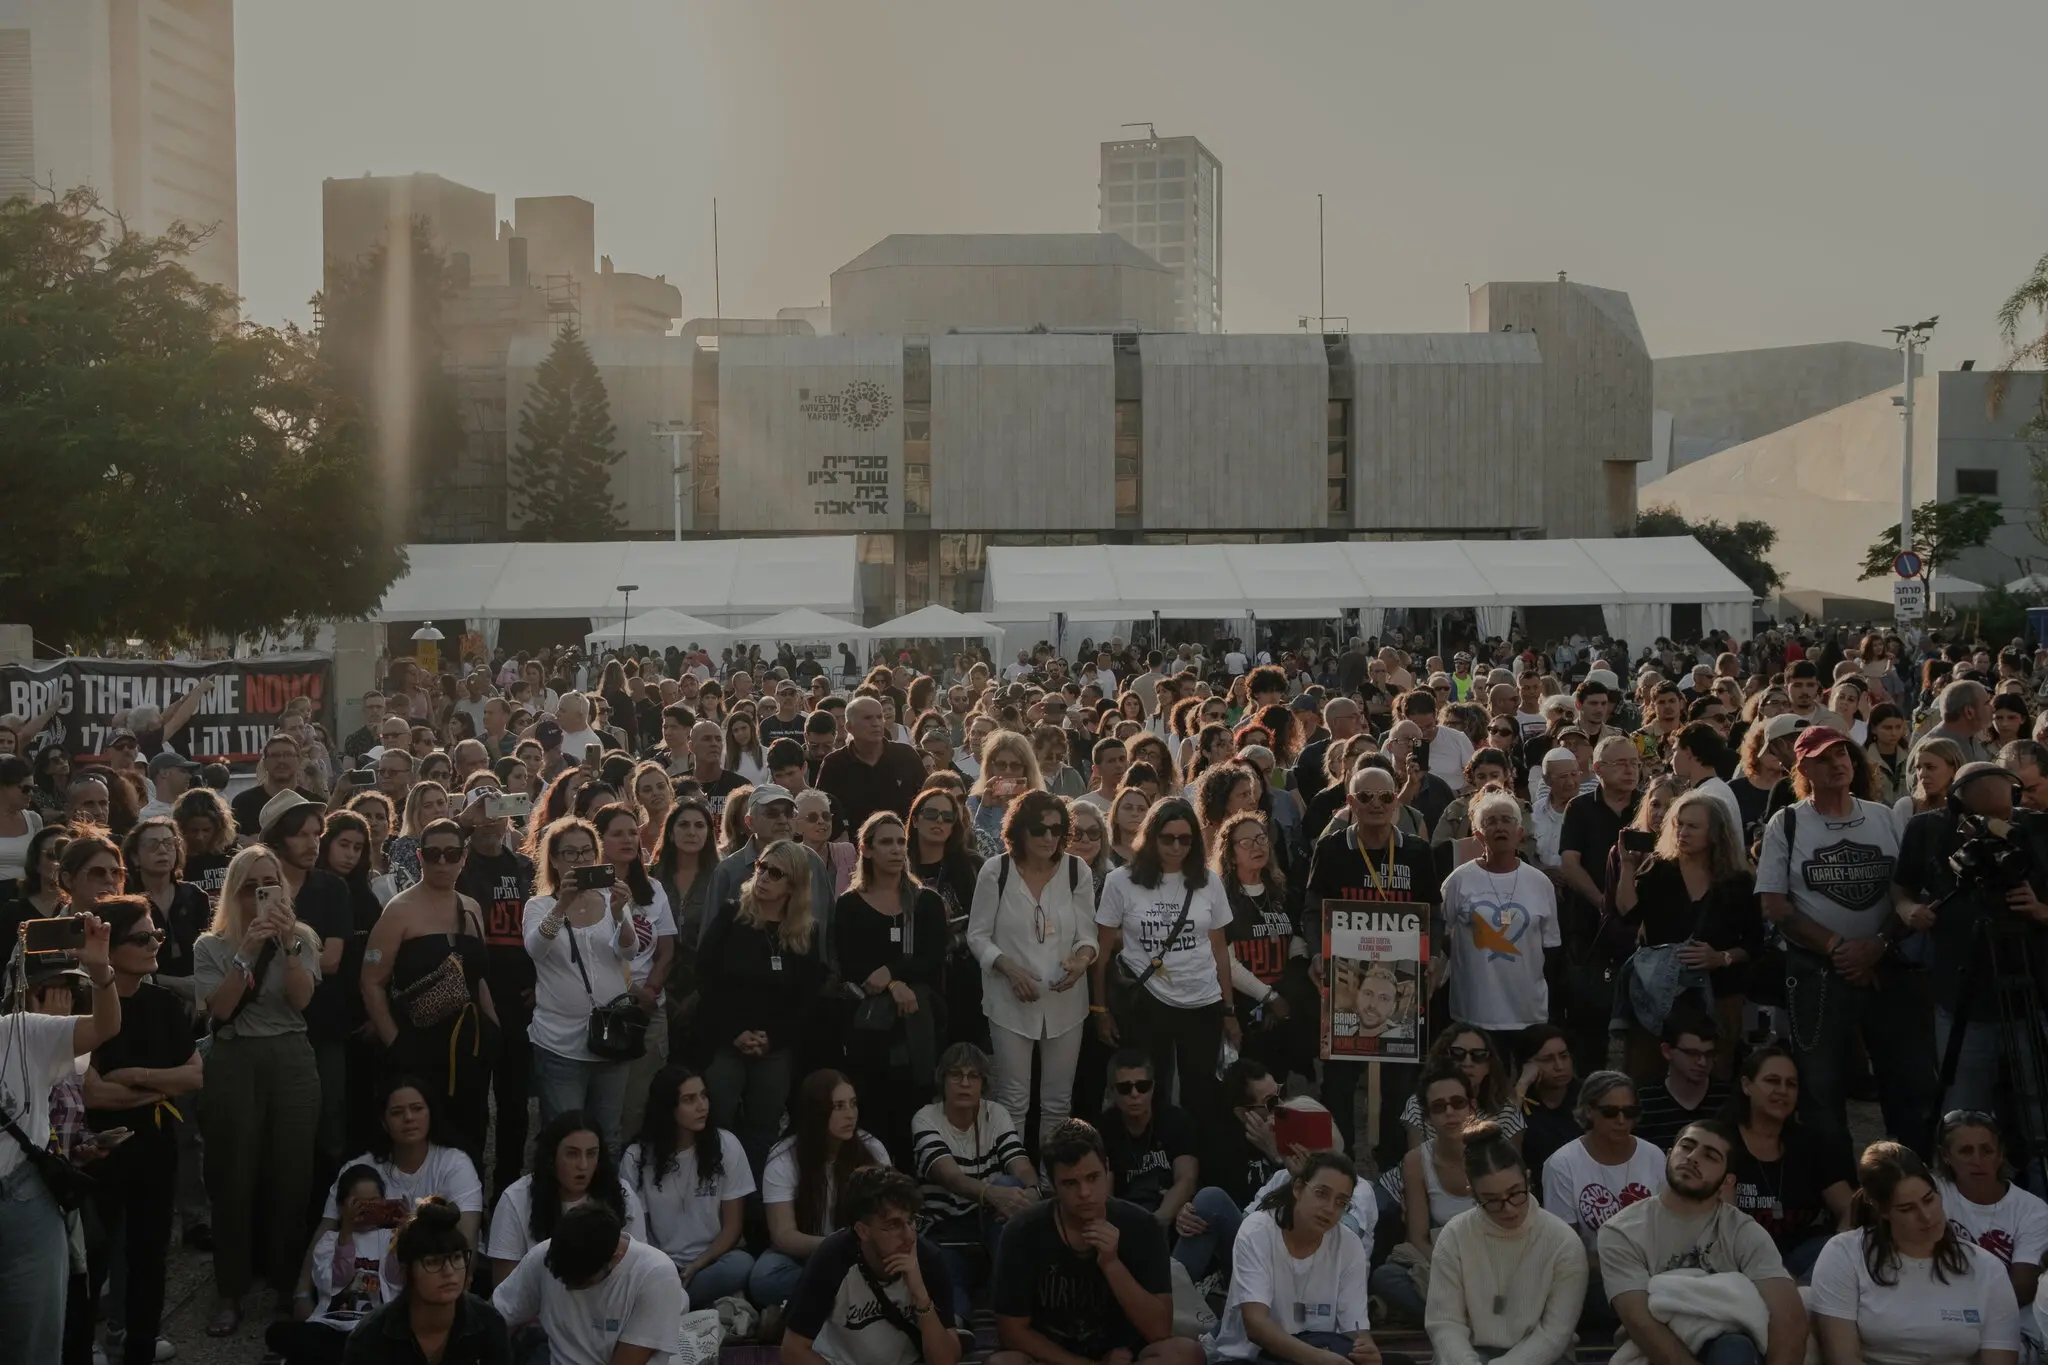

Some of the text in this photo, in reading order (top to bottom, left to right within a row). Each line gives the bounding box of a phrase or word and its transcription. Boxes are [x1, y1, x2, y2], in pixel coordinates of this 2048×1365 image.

[822, 455, 888, 469] ספריית
[854, 486, 889, 499] בית
[1895, 586, 1921, 595] מרחב
[80, 674, 157, 715] THEM
[1380, 863, 1412, 877] מחזיים
[1363, 874, 1389, 889] הבתה
[493, 886, 513, 900] הבית
[1331, 910, 1421, 932] BRING
[1140, 919, 1195, 940] כדיון
[1334, 1012, 1357, 1025] BRING
[1334, 1024, 1350, 1037] HIM
